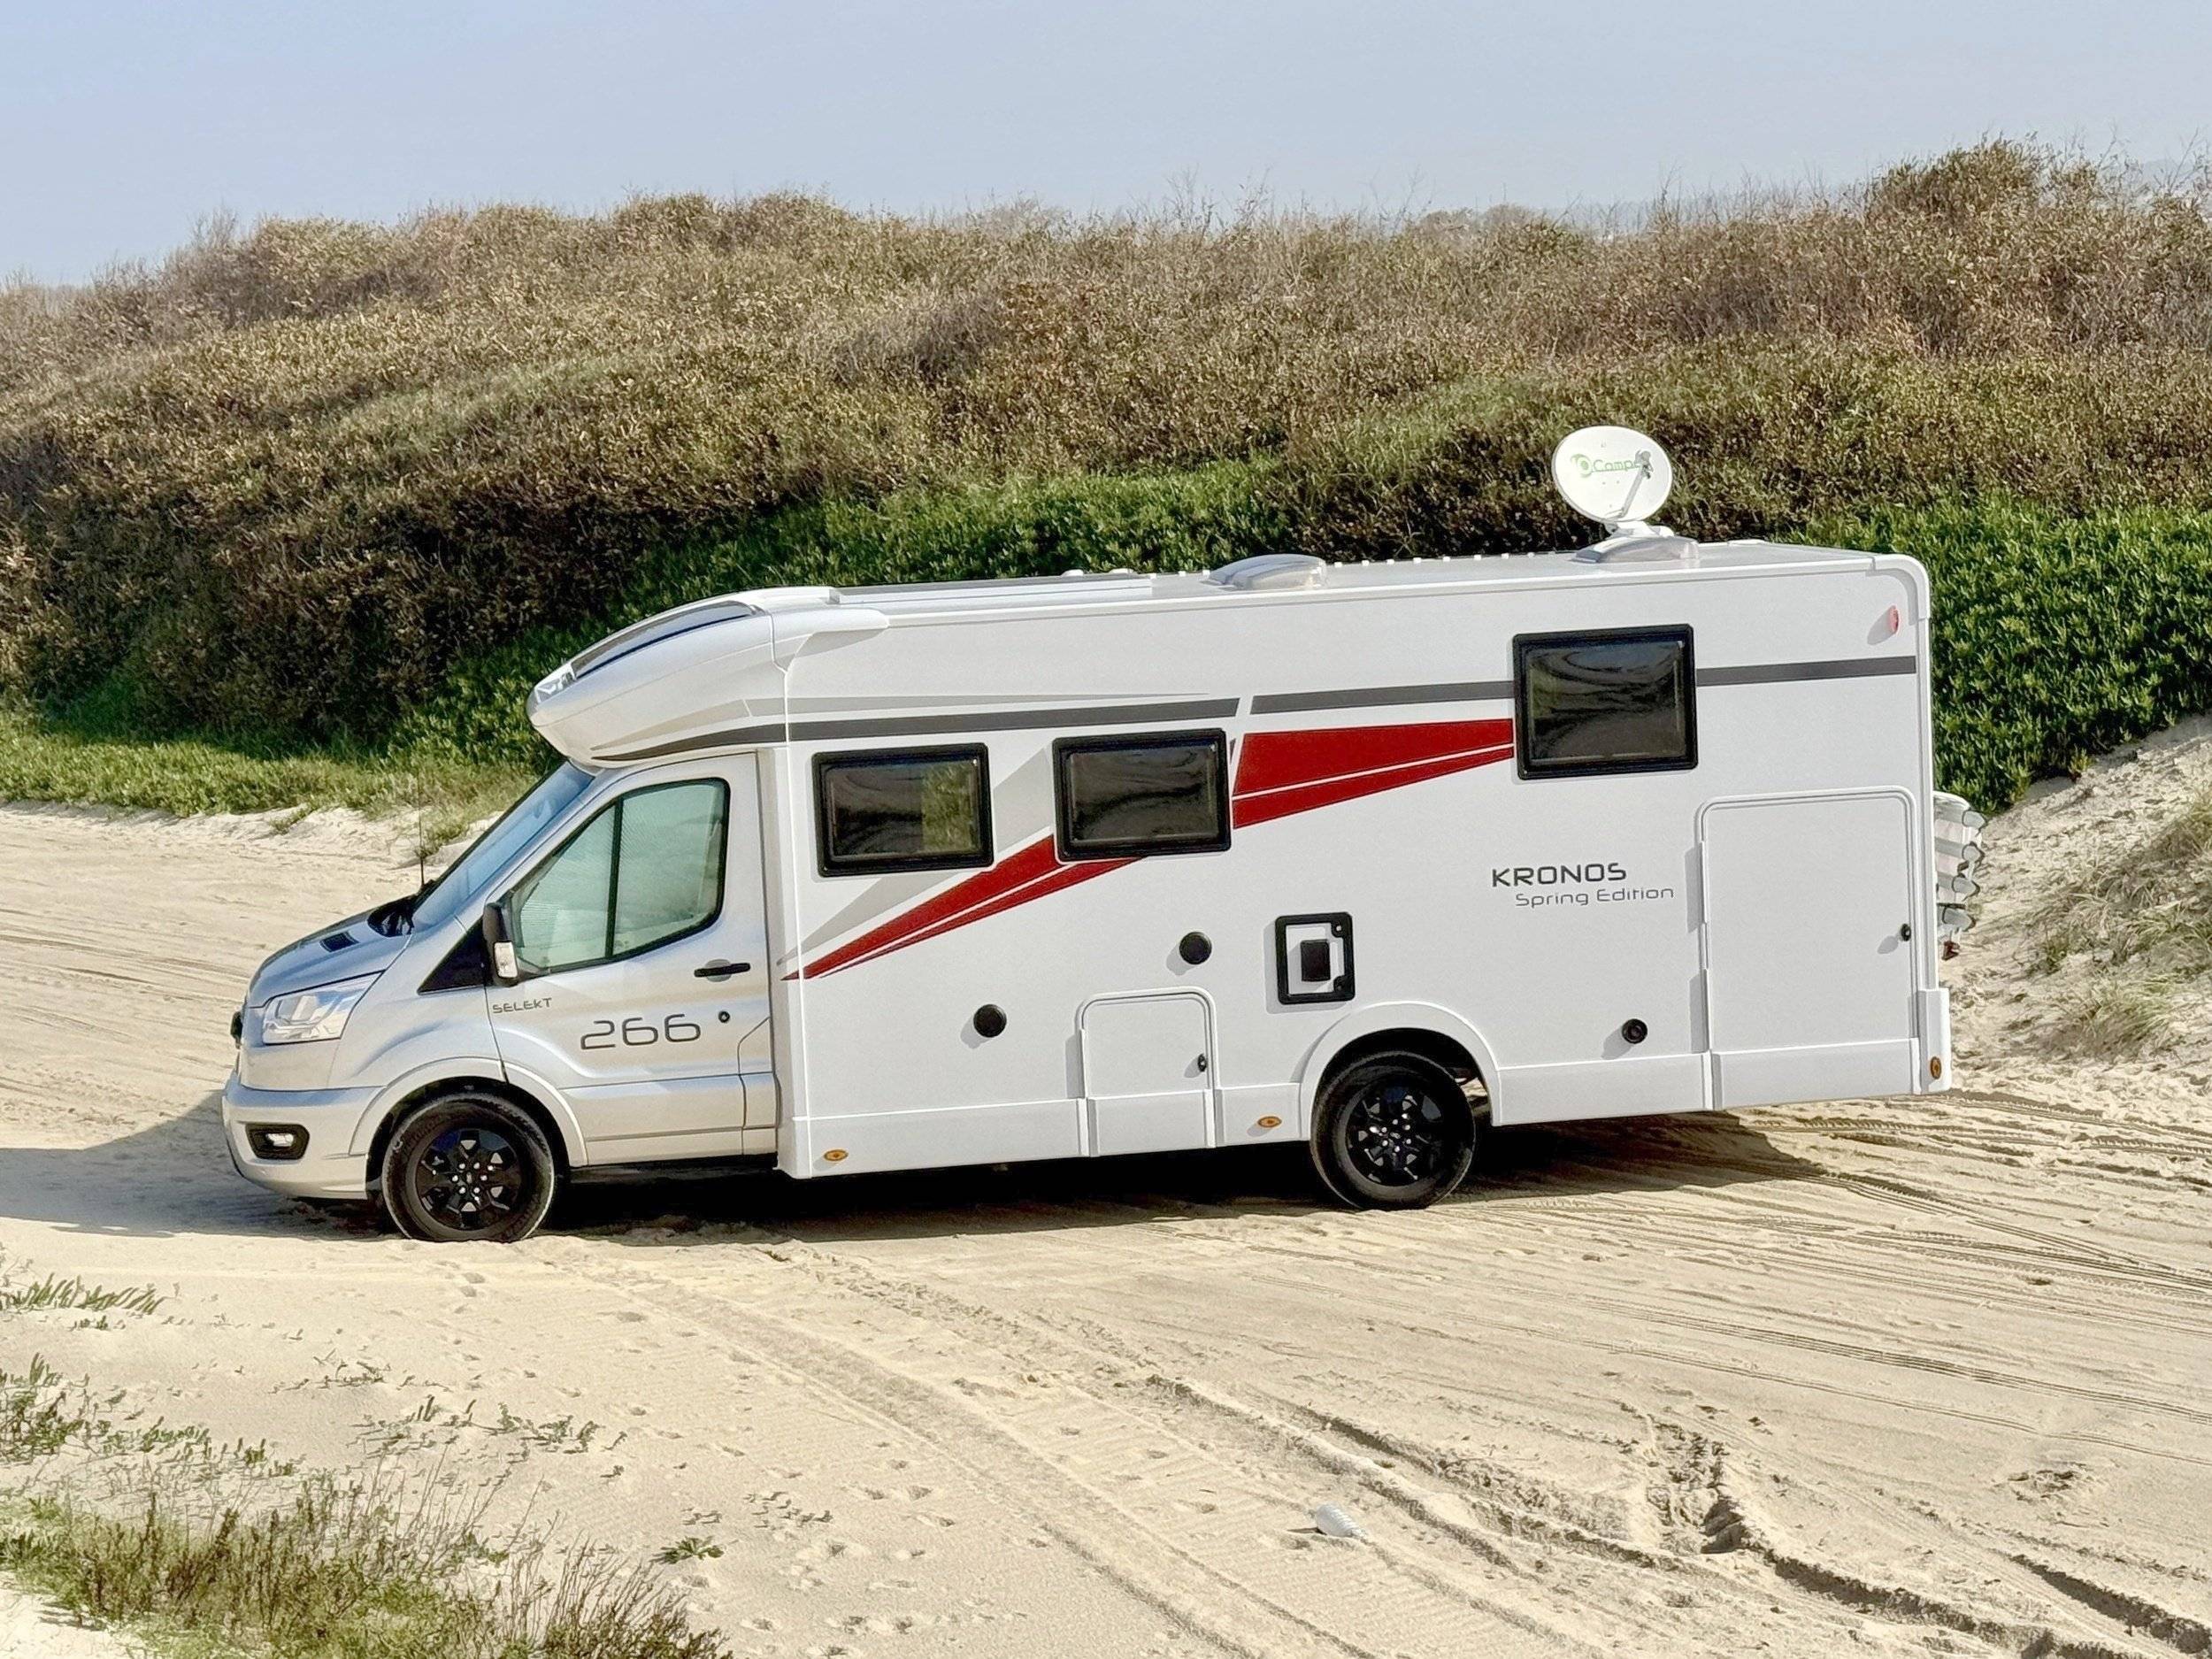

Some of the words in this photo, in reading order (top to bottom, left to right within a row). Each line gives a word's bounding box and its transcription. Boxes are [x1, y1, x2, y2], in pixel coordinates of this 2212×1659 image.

[1492, 862, 1626, 887] KRONOS
[1515, 892, 1589, 909] Spring
[1596, 887, 1674, 902] Edition
[580, 1013, 701, 1050] 266
